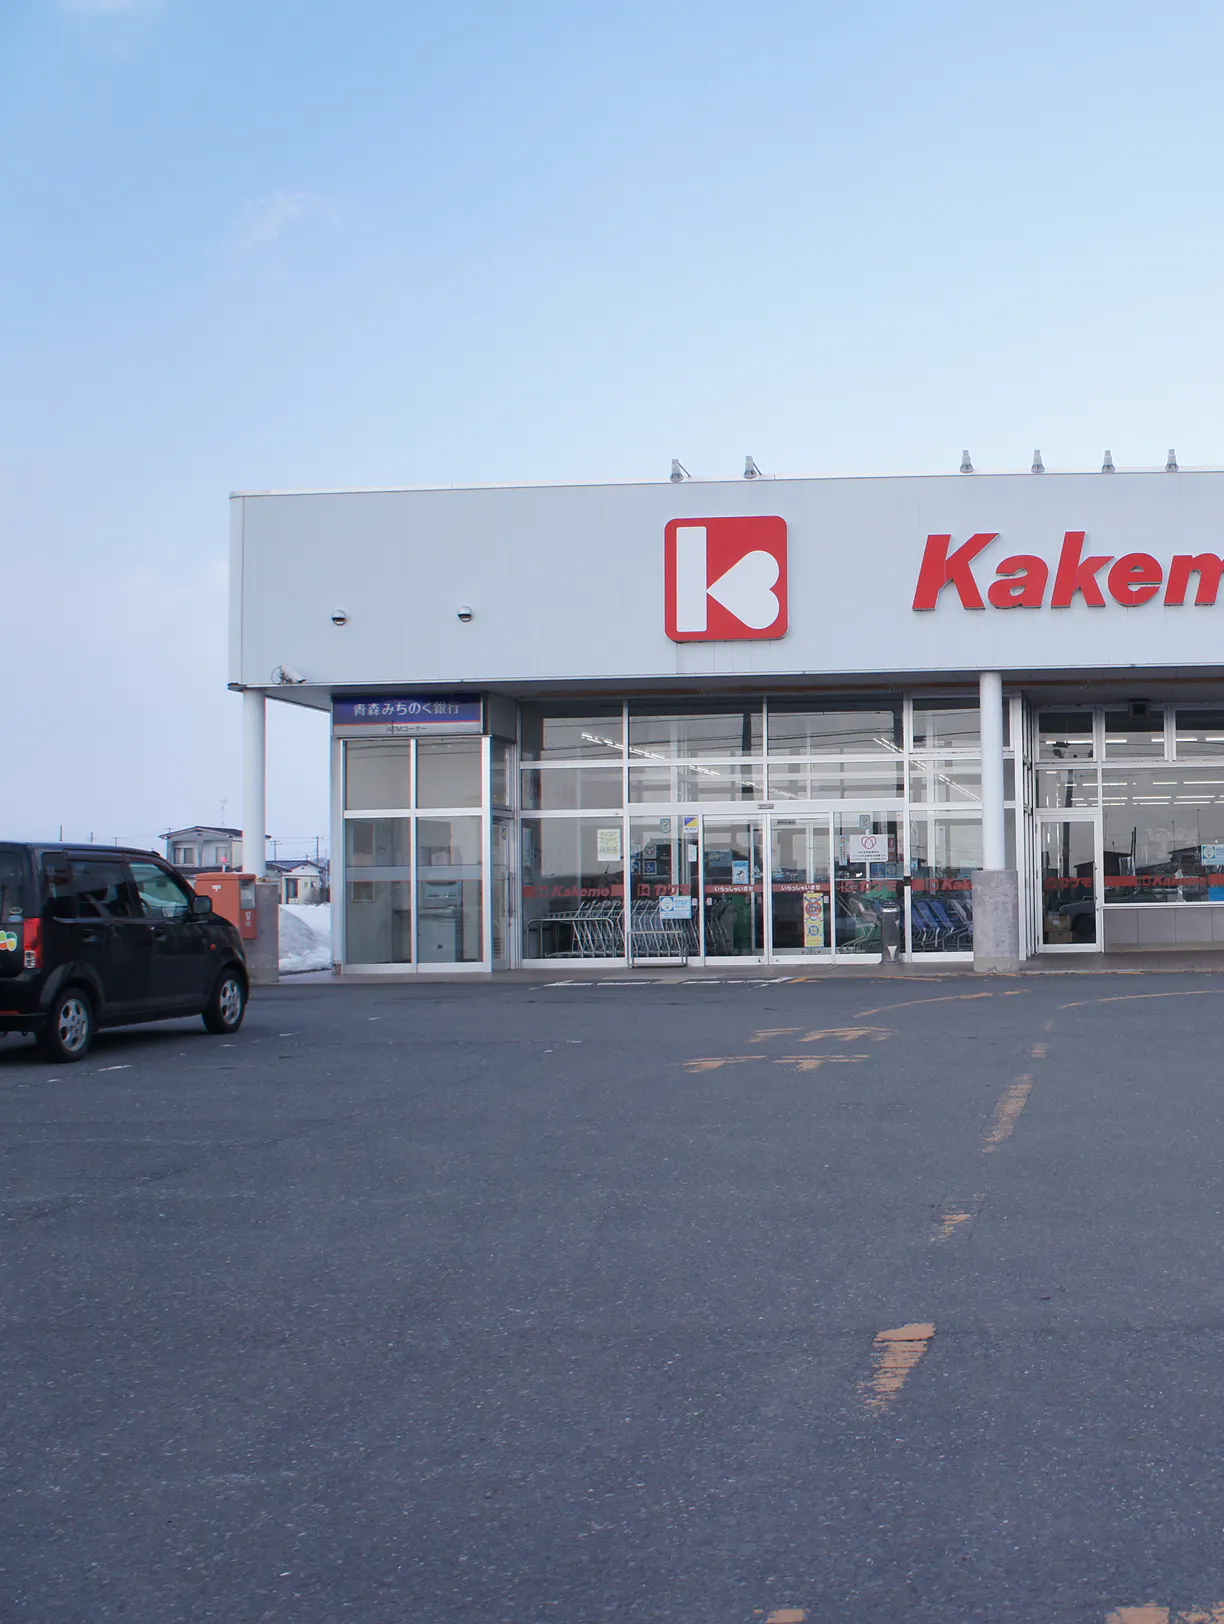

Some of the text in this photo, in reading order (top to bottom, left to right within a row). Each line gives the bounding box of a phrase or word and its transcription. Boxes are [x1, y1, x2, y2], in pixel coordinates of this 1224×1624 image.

[352, 701, 461, 717] 青森みちのく銀行
[551, 885, 611, 897] Kakemo
[714, 885, 754, 893] いらっしゃいませ
[781, 884, 821, 892] いらっしゃいませ
